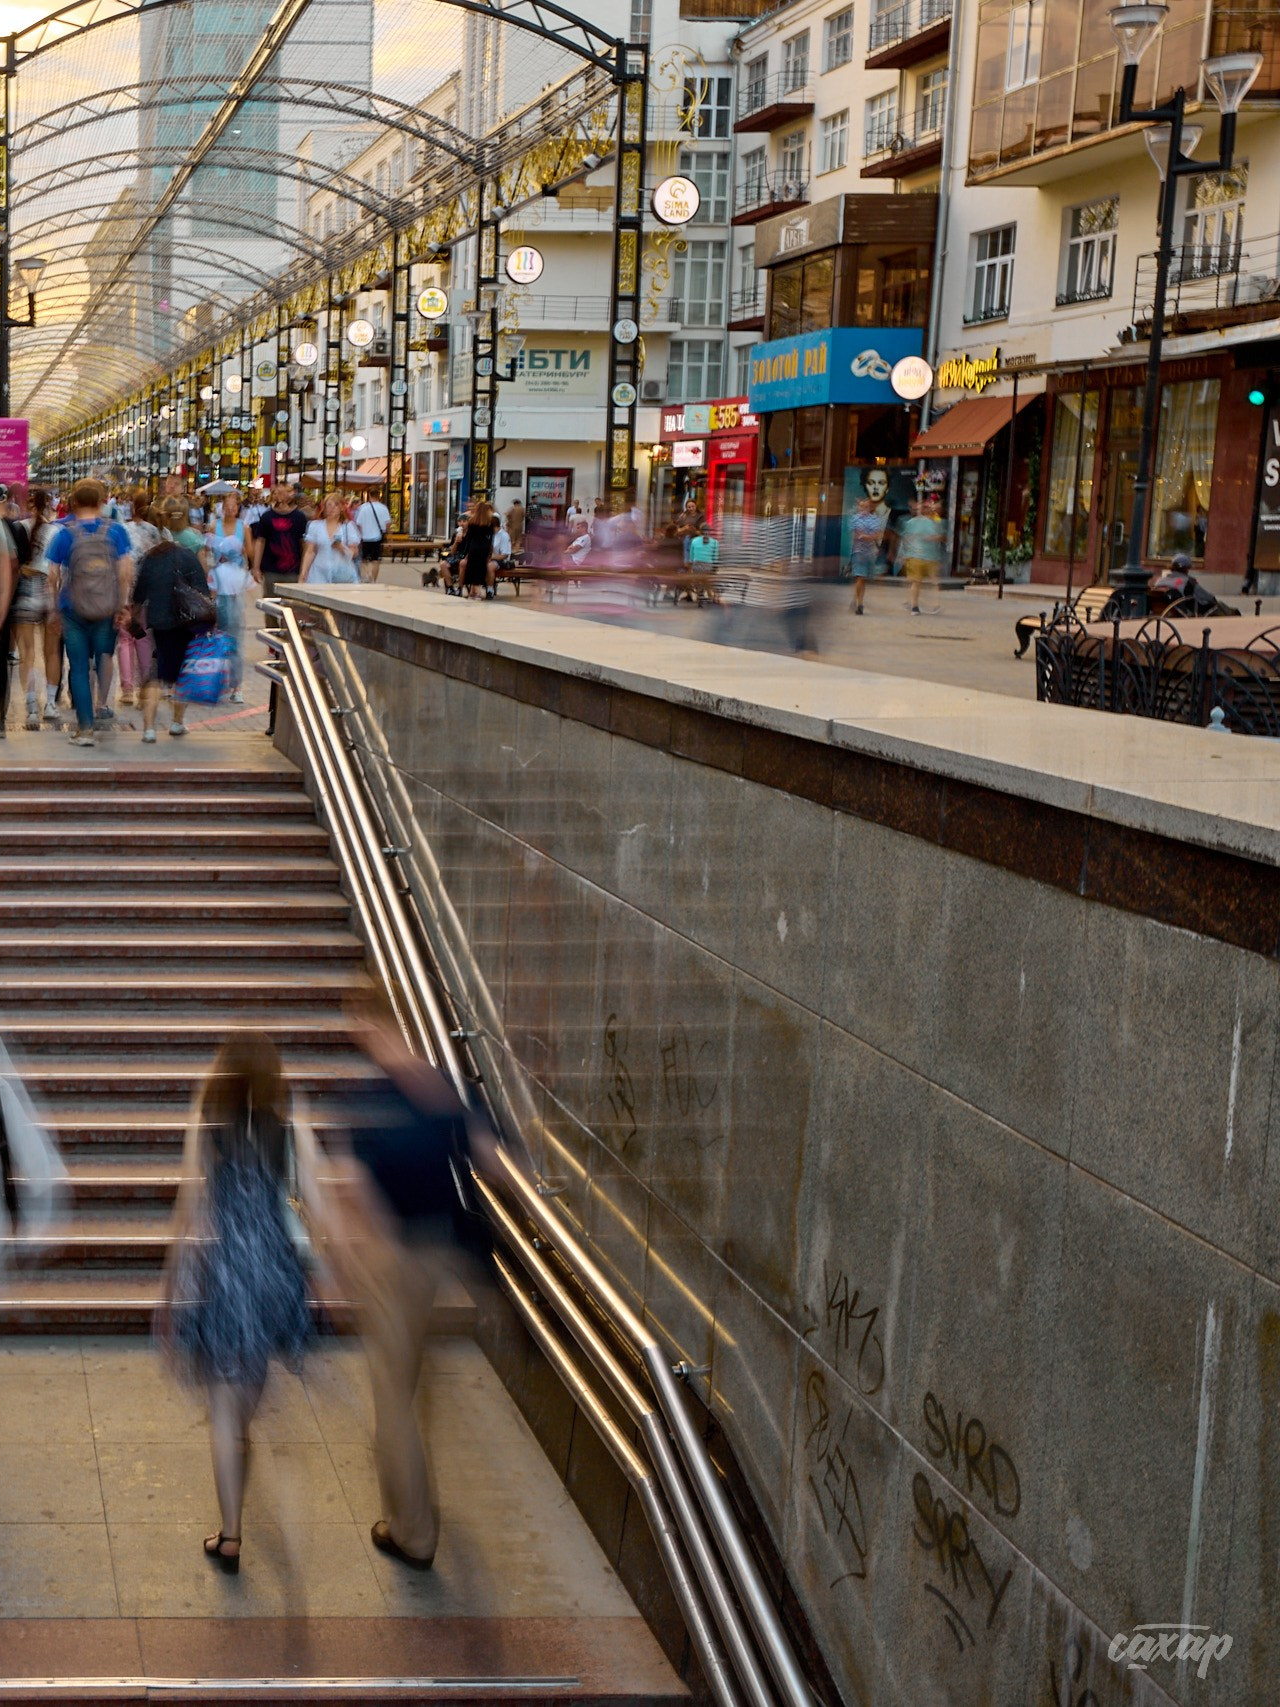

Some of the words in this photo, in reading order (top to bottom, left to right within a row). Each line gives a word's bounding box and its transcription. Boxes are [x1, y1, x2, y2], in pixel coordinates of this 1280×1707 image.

[663, 200, 689, 209] SIMA
[663, 209, 690, 218] LAND
[528, 349, 591, 370] БТИ
[752, 348, 799, 386] ЗОЛОТОЙ
[804, 341, 827, 377] РАЙ
